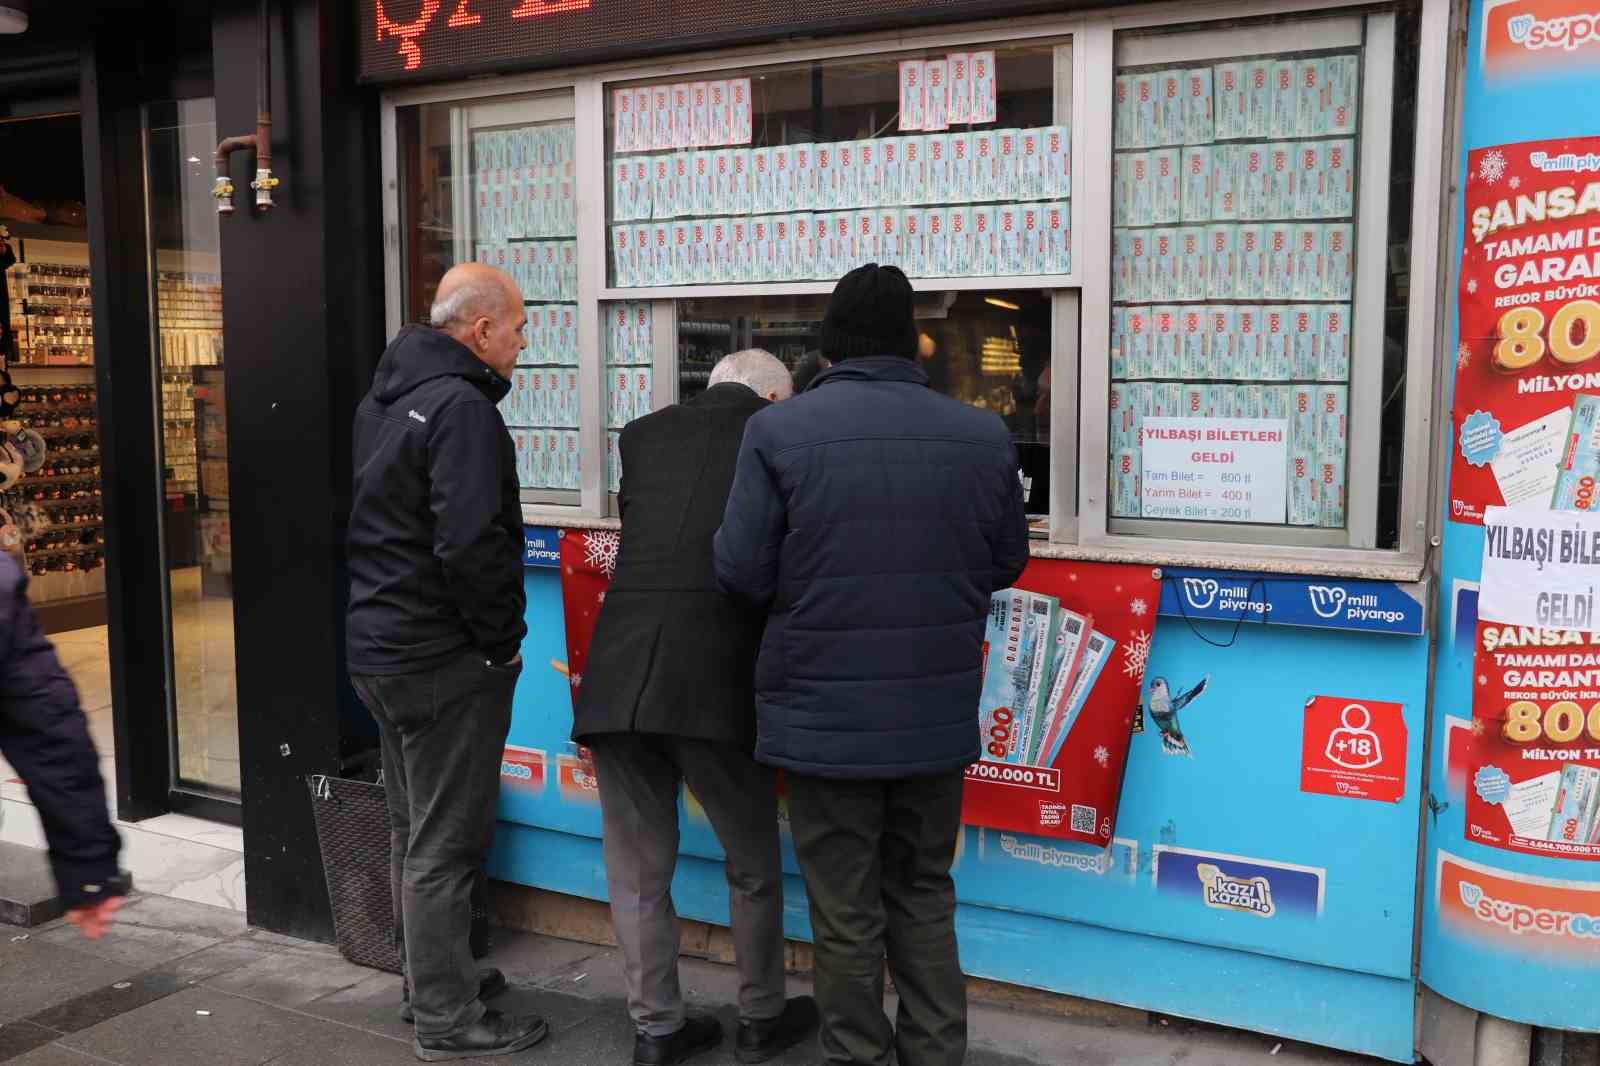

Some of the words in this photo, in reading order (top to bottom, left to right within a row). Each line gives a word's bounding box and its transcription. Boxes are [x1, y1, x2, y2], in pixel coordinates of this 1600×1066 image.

[1529, 18, 1600, 47] süp
[1543, 155, 1574, 170] milli
[1483, 228, 1584, 262] TAMAMI
[1495, 292, 1541, 308] REKOR
[1545, 284, 1600, 302] BÜYÜK
[1145, 428, 1201, 442] YILBAŞI
[1206, 428, 1283, 443] BİLETLERİ
[1191, 451, 1234, 464] GELDİ
[1295, 458, 1306, 476] 800
[1144, 470, 1168, 481] Tam
[1171, 471, 1195, 482] Bilet
[1220, 472, 1241, 484] 800
[1144, 487, 1176, 499] Yarım
[1178, 488, 1202, 500] Bilet
[1221, 489, 1242, 501] 400
[1143, 504, 1181, 517] Çeyrek
[1184, 506, 1208, 517] Bilet
[1219, 507, 1242, 518] 200
[527, 539, 545, 549] milli
[1486, 524, 1554, 571] YILBAŞI
[1219, 586, 1248, 599] milli
[1219, 598, 1273, 613] piyango
[1347, 595, 1378, 608] milli
[1536, 585, 1593, 627] GELDİ
[1347, 607, 1405, 623] piyango
[1494, 653, 1566, 668] TAMAMI
[1569, 653, 1600, 667] DA
[1504, 691, 1538, 700] REKOR
[1540, 690, 1578, 701] BÜYÜK
[987, 705, 1013, 758] 800
[1335, 738, 1371, 757] +18
[1522, 748, 1580, 760] MİLYON
[1036, 771, 1055, 787] TL
[1014, 843, 1040, 858] milli
[1216, 876, 1256, 897] kazı
